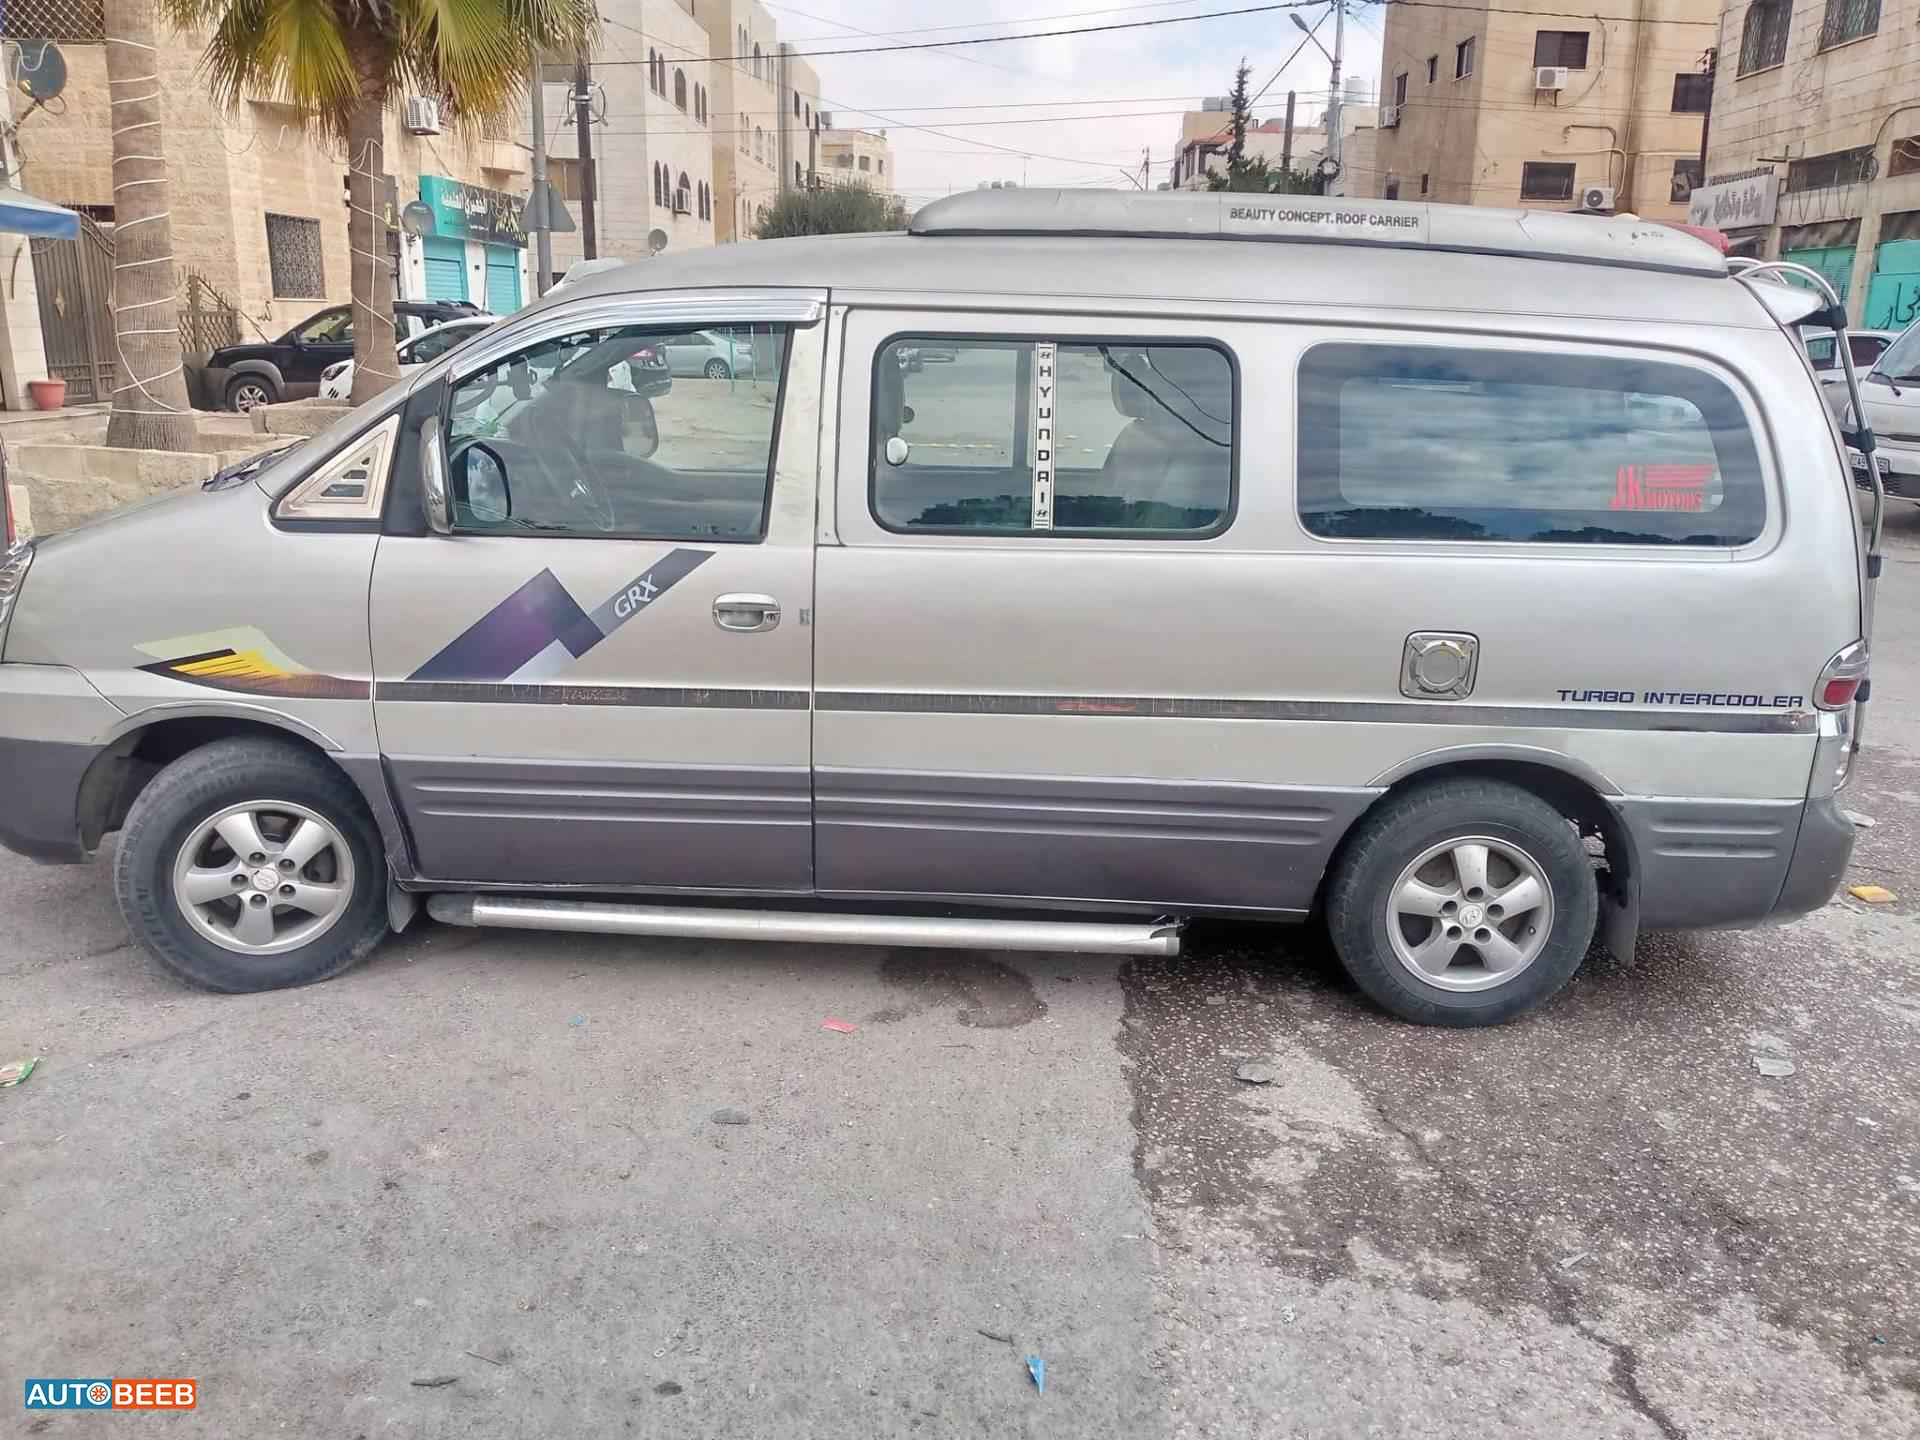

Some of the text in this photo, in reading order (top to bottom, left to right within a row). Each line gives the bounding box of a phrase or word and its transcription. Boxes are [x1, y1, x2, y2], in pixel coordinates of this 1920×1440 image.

[1230, 207, 1276, 221] BEAUTY
[1369, 214, 1419, 228] CARRIER
[1036, 365, 1052, 504] HYUNDAI
[1609, 463, 1644, 511] JK
[1645, 490, 1704, 511] MOTORS
[614, 573, 659, 618] GRX
[1556, 689, 1804, 708] TURBO INTERCOOLER
